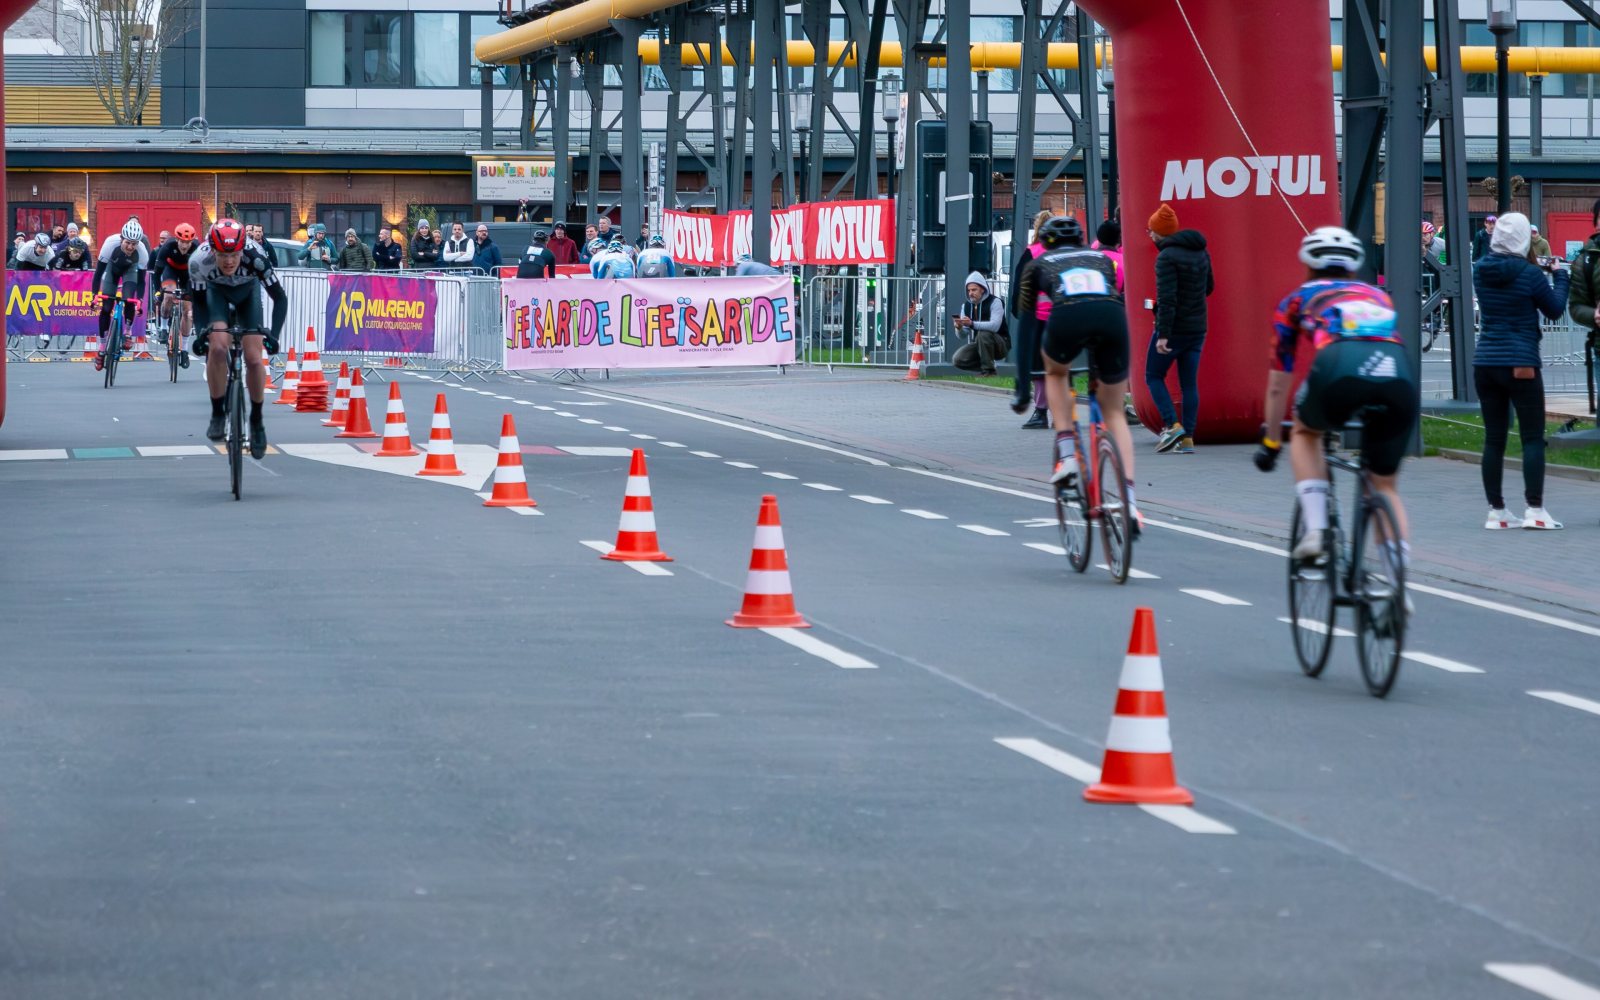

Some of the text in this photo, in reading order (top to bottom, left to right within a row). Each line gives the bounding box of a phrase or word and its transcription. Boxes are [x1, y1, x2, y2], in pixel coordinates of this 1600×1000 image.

[481, 162, 555, 177] BUNTER HUN
[1160, 155, 1326, 201] MOTUL
[663, 212, 714, 263] MOTUL
[816, 205, 885, 260] MOTUL
[53, 308, 101, 317] CUSTOM CYCLIN
[366, 299, 425, 319] MILREMO
